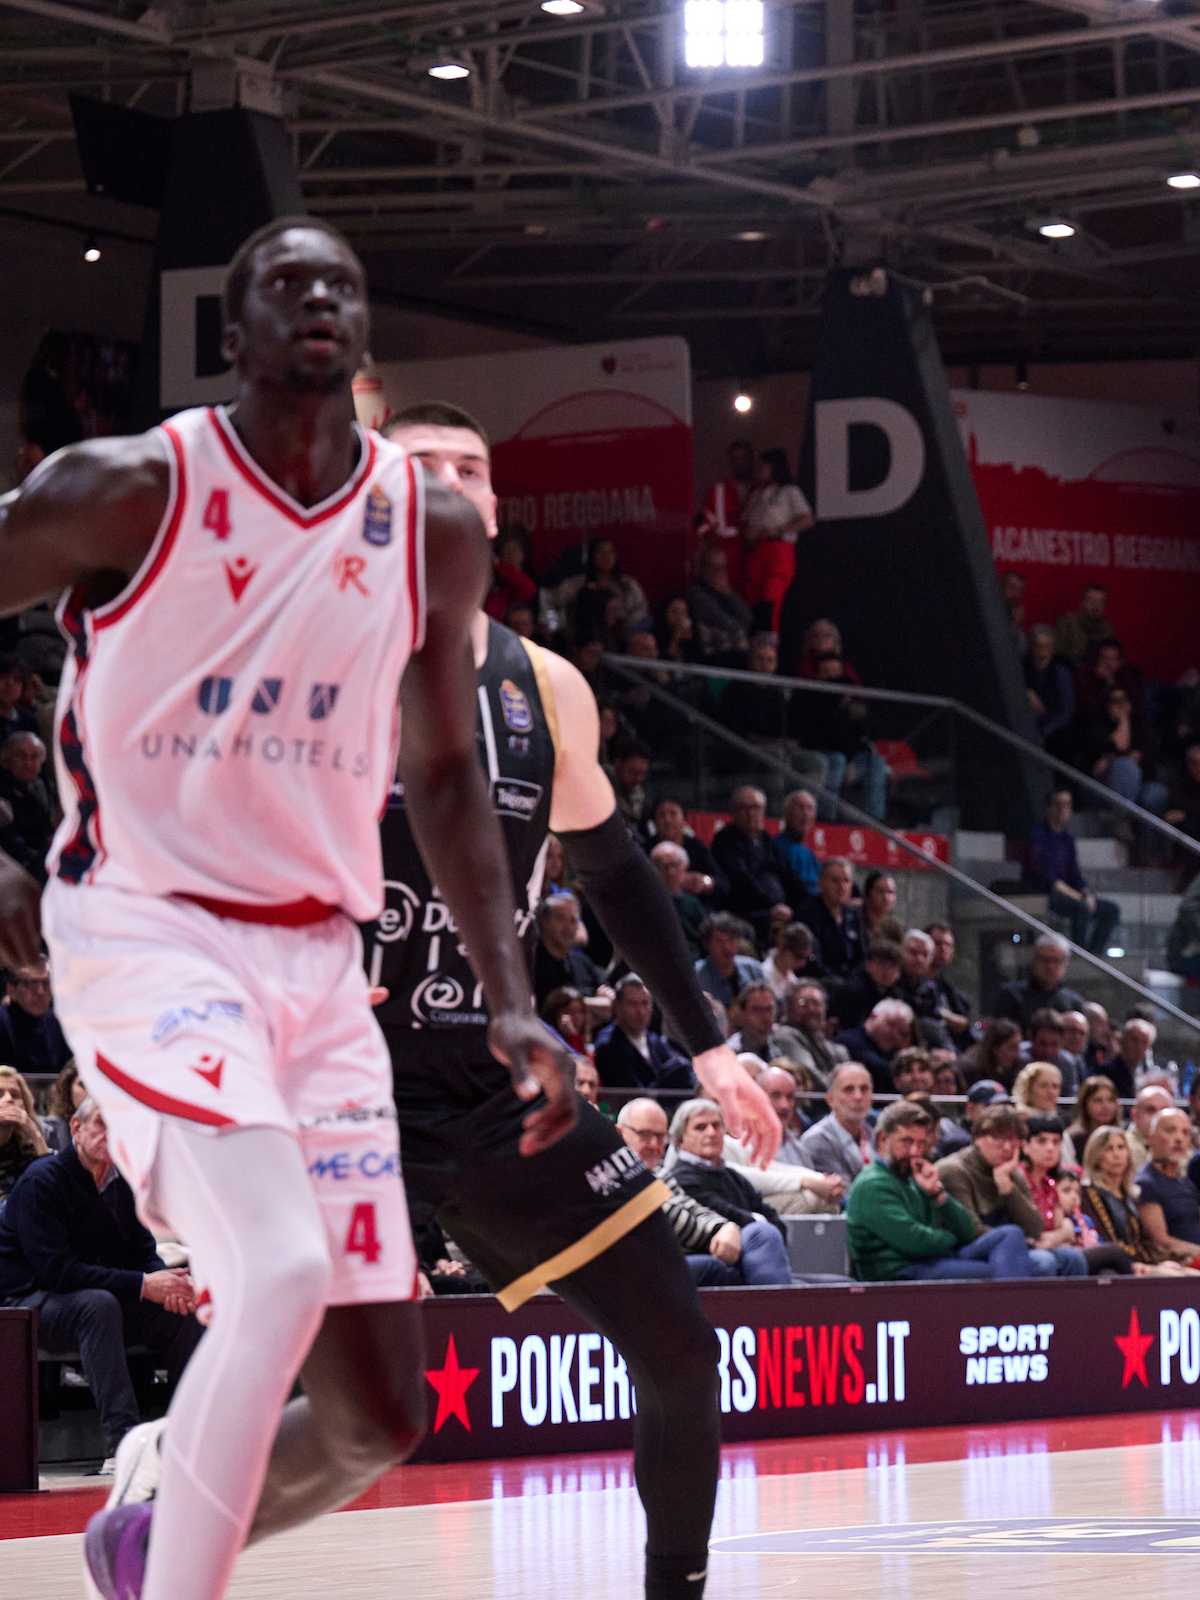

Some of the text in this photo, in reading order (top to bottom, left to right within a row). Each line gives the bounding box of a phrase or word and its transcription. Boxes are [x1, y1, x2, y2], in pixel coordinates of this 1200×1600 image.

[815, 396, 926, 521] D
[203, 488, 232, 541] 4
[141, 731, 369, 779] UNA HOTELS
[343, 1201, 383, 1265] 4
[959, 1322, 1055, 1356] SPORT
[965, 1353, 1049, 1386] NEWS
